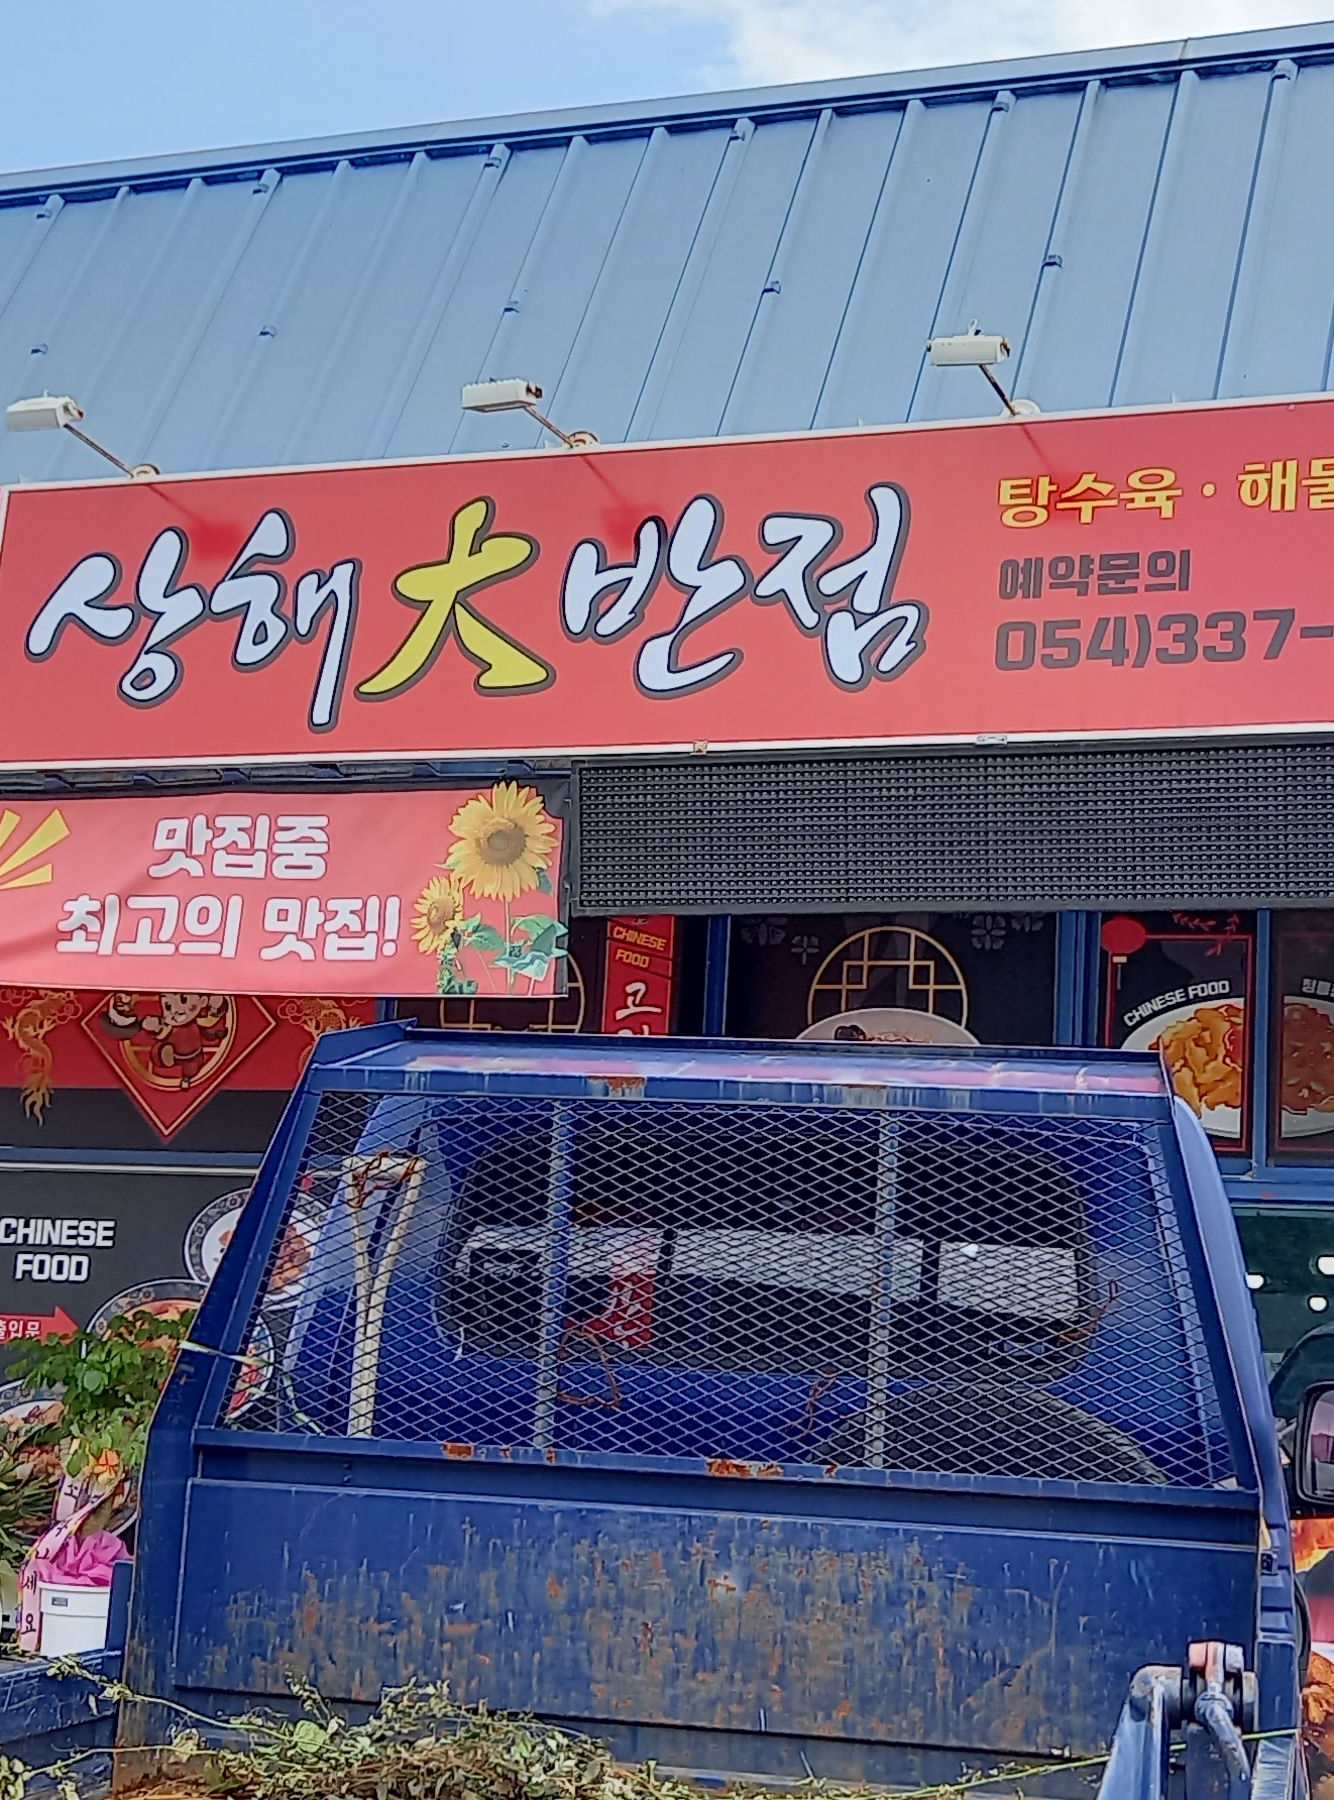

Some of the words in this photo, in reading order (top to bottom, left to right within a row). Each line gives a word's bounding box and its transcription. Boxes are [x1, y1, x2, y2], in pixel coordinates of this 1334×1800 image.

[998, 466, 1183, 528] 탕수육
[998, 549, 1192, 600] 예약문의
[152, 813, 331, 881] 맛집중
[55, 893, 242, 958] 최고의
[262, 894, 402, 962] 맛집!
[612, 926, 667, 951] CHINESE
[615, 949, 650, 968] FOOD
[1123, 986, 1188, 1028] CHINESE
[1187, 979, 1231, 998] FOOD
[15, 1253, 90, 1282] FOOD
